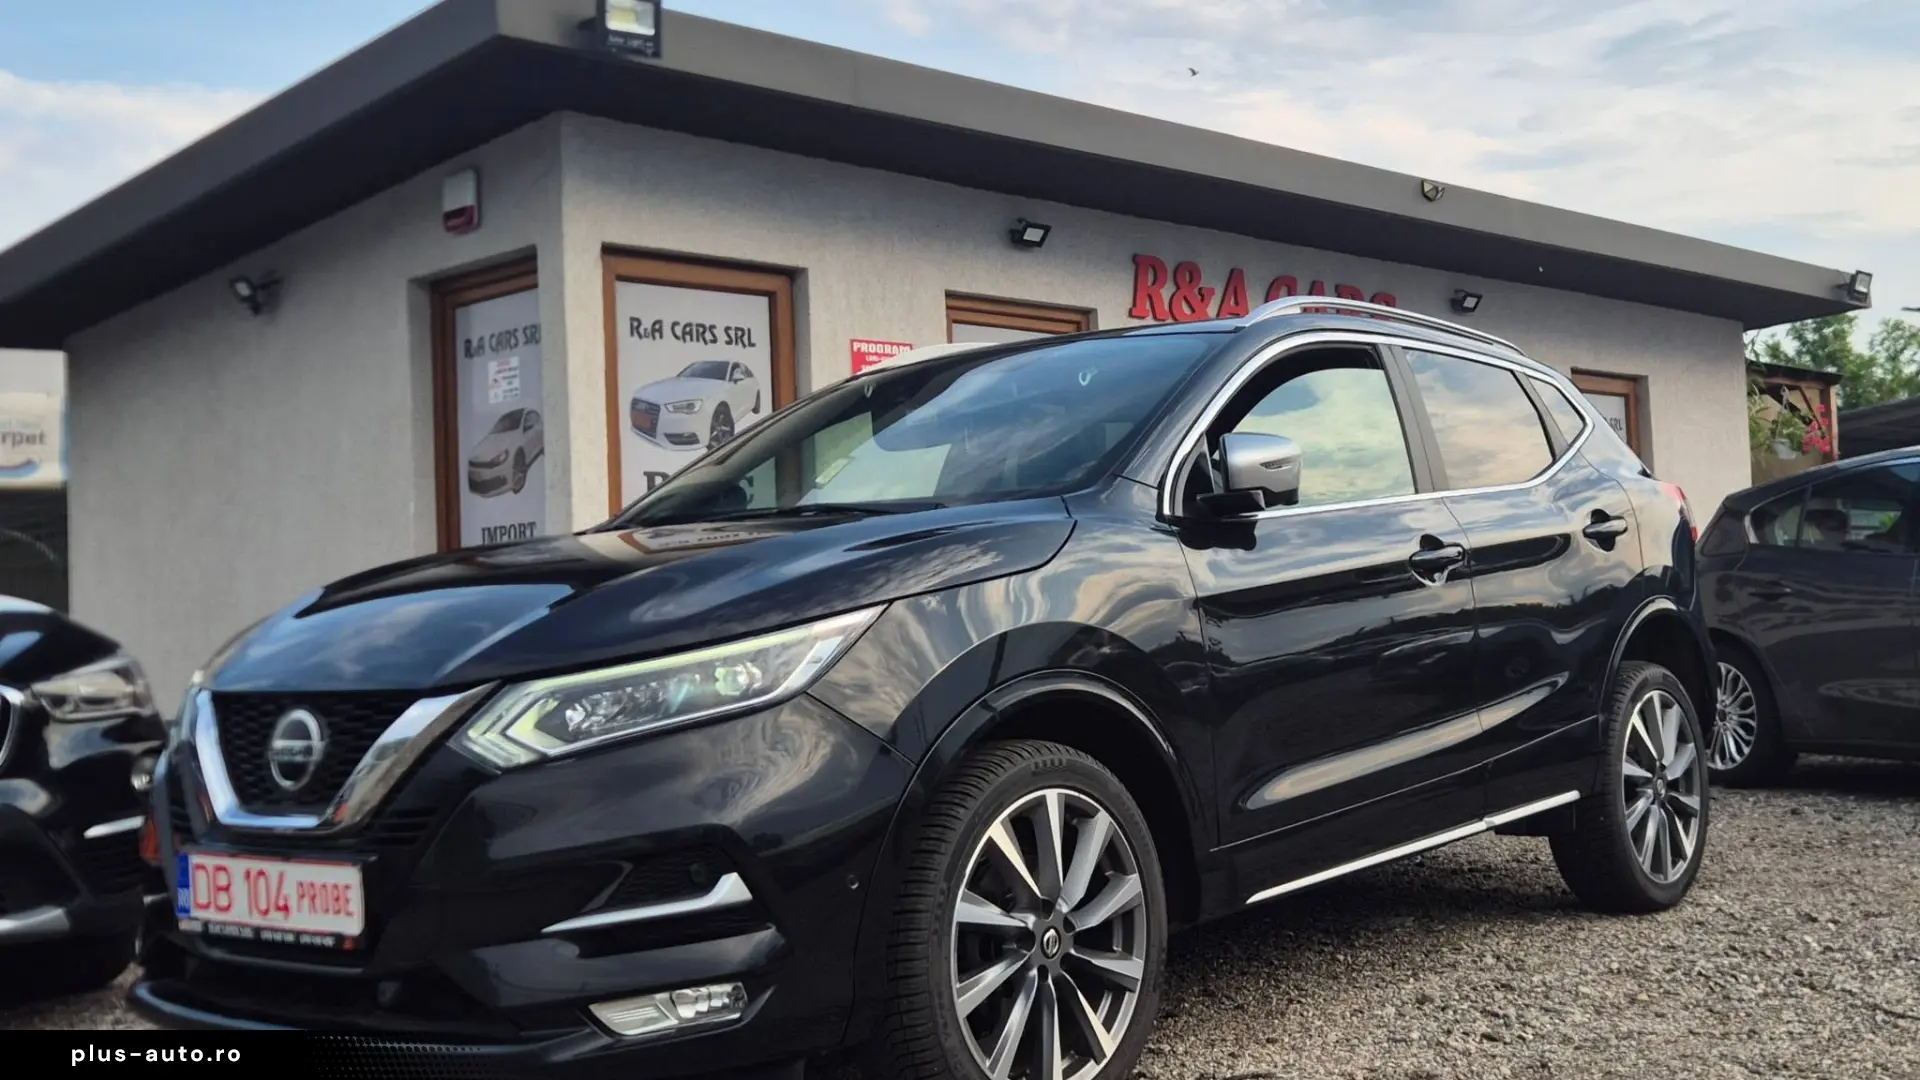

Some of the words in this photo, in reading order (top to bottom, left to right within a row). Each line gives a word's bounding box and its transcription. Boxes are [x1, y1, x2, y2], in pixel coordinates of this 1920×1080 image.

[1128, 253, 1250, 322] R&A
[488, 326, 520, 354] CARS
[629, 316, 664, 341] R&A
[670, 320, 718, 346] CARS
[723, 325, 757, 349] SRL
[481, 520, 538, 545] IMPORT
[192, 863, 233, 913] DB
[243, 867, 292, 920] 104
[296, 880, 355, 917] PROBE
